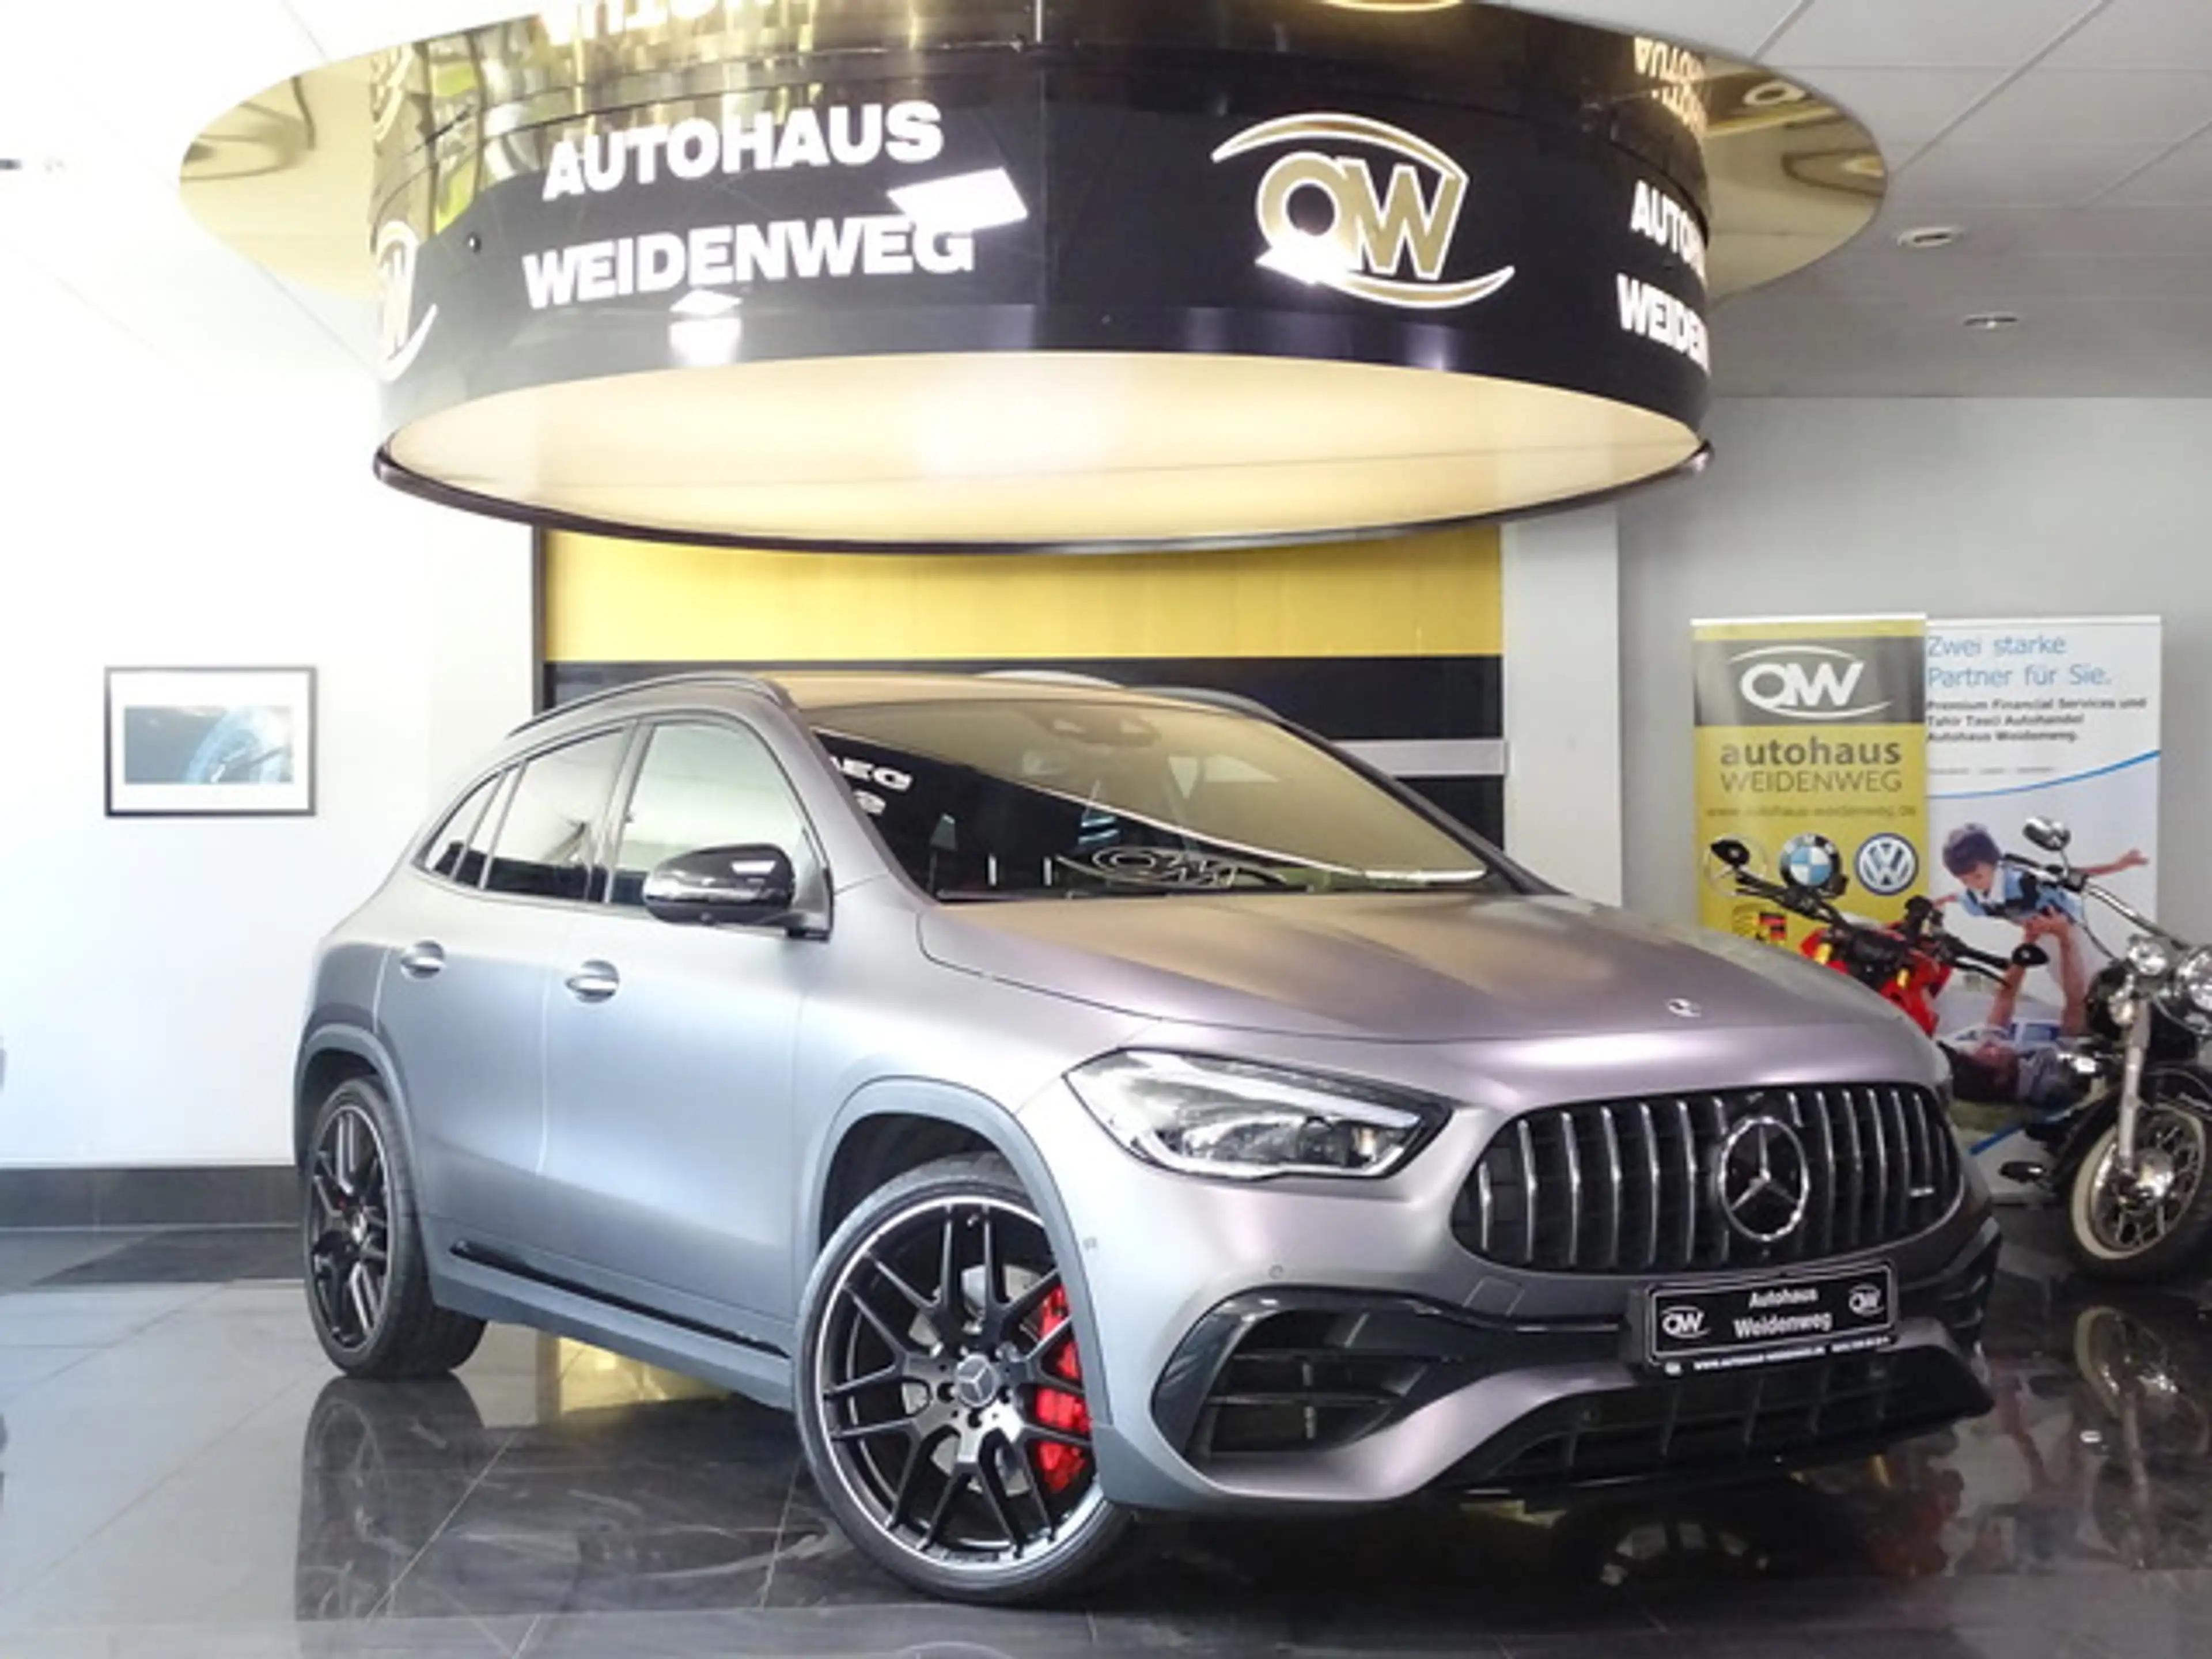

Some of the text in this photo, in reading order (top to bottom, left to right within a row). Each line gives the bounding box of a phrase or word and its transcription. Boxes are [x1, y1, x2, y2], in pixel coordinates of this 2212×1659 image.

[542, 100, 944, 201] AUTOHAUS
[1631, 180, 1708, 286] AUTO
[522, 215, 975, 310] WEIDENWEG
[1929, 635, 2067, 657] Zwei starke
[1929, 663, 2112, 688] Partner für Sie.
[1720, 736, 1903, 766] autohaus
[1720, 770, 1903, 793] WEIDENWEG
